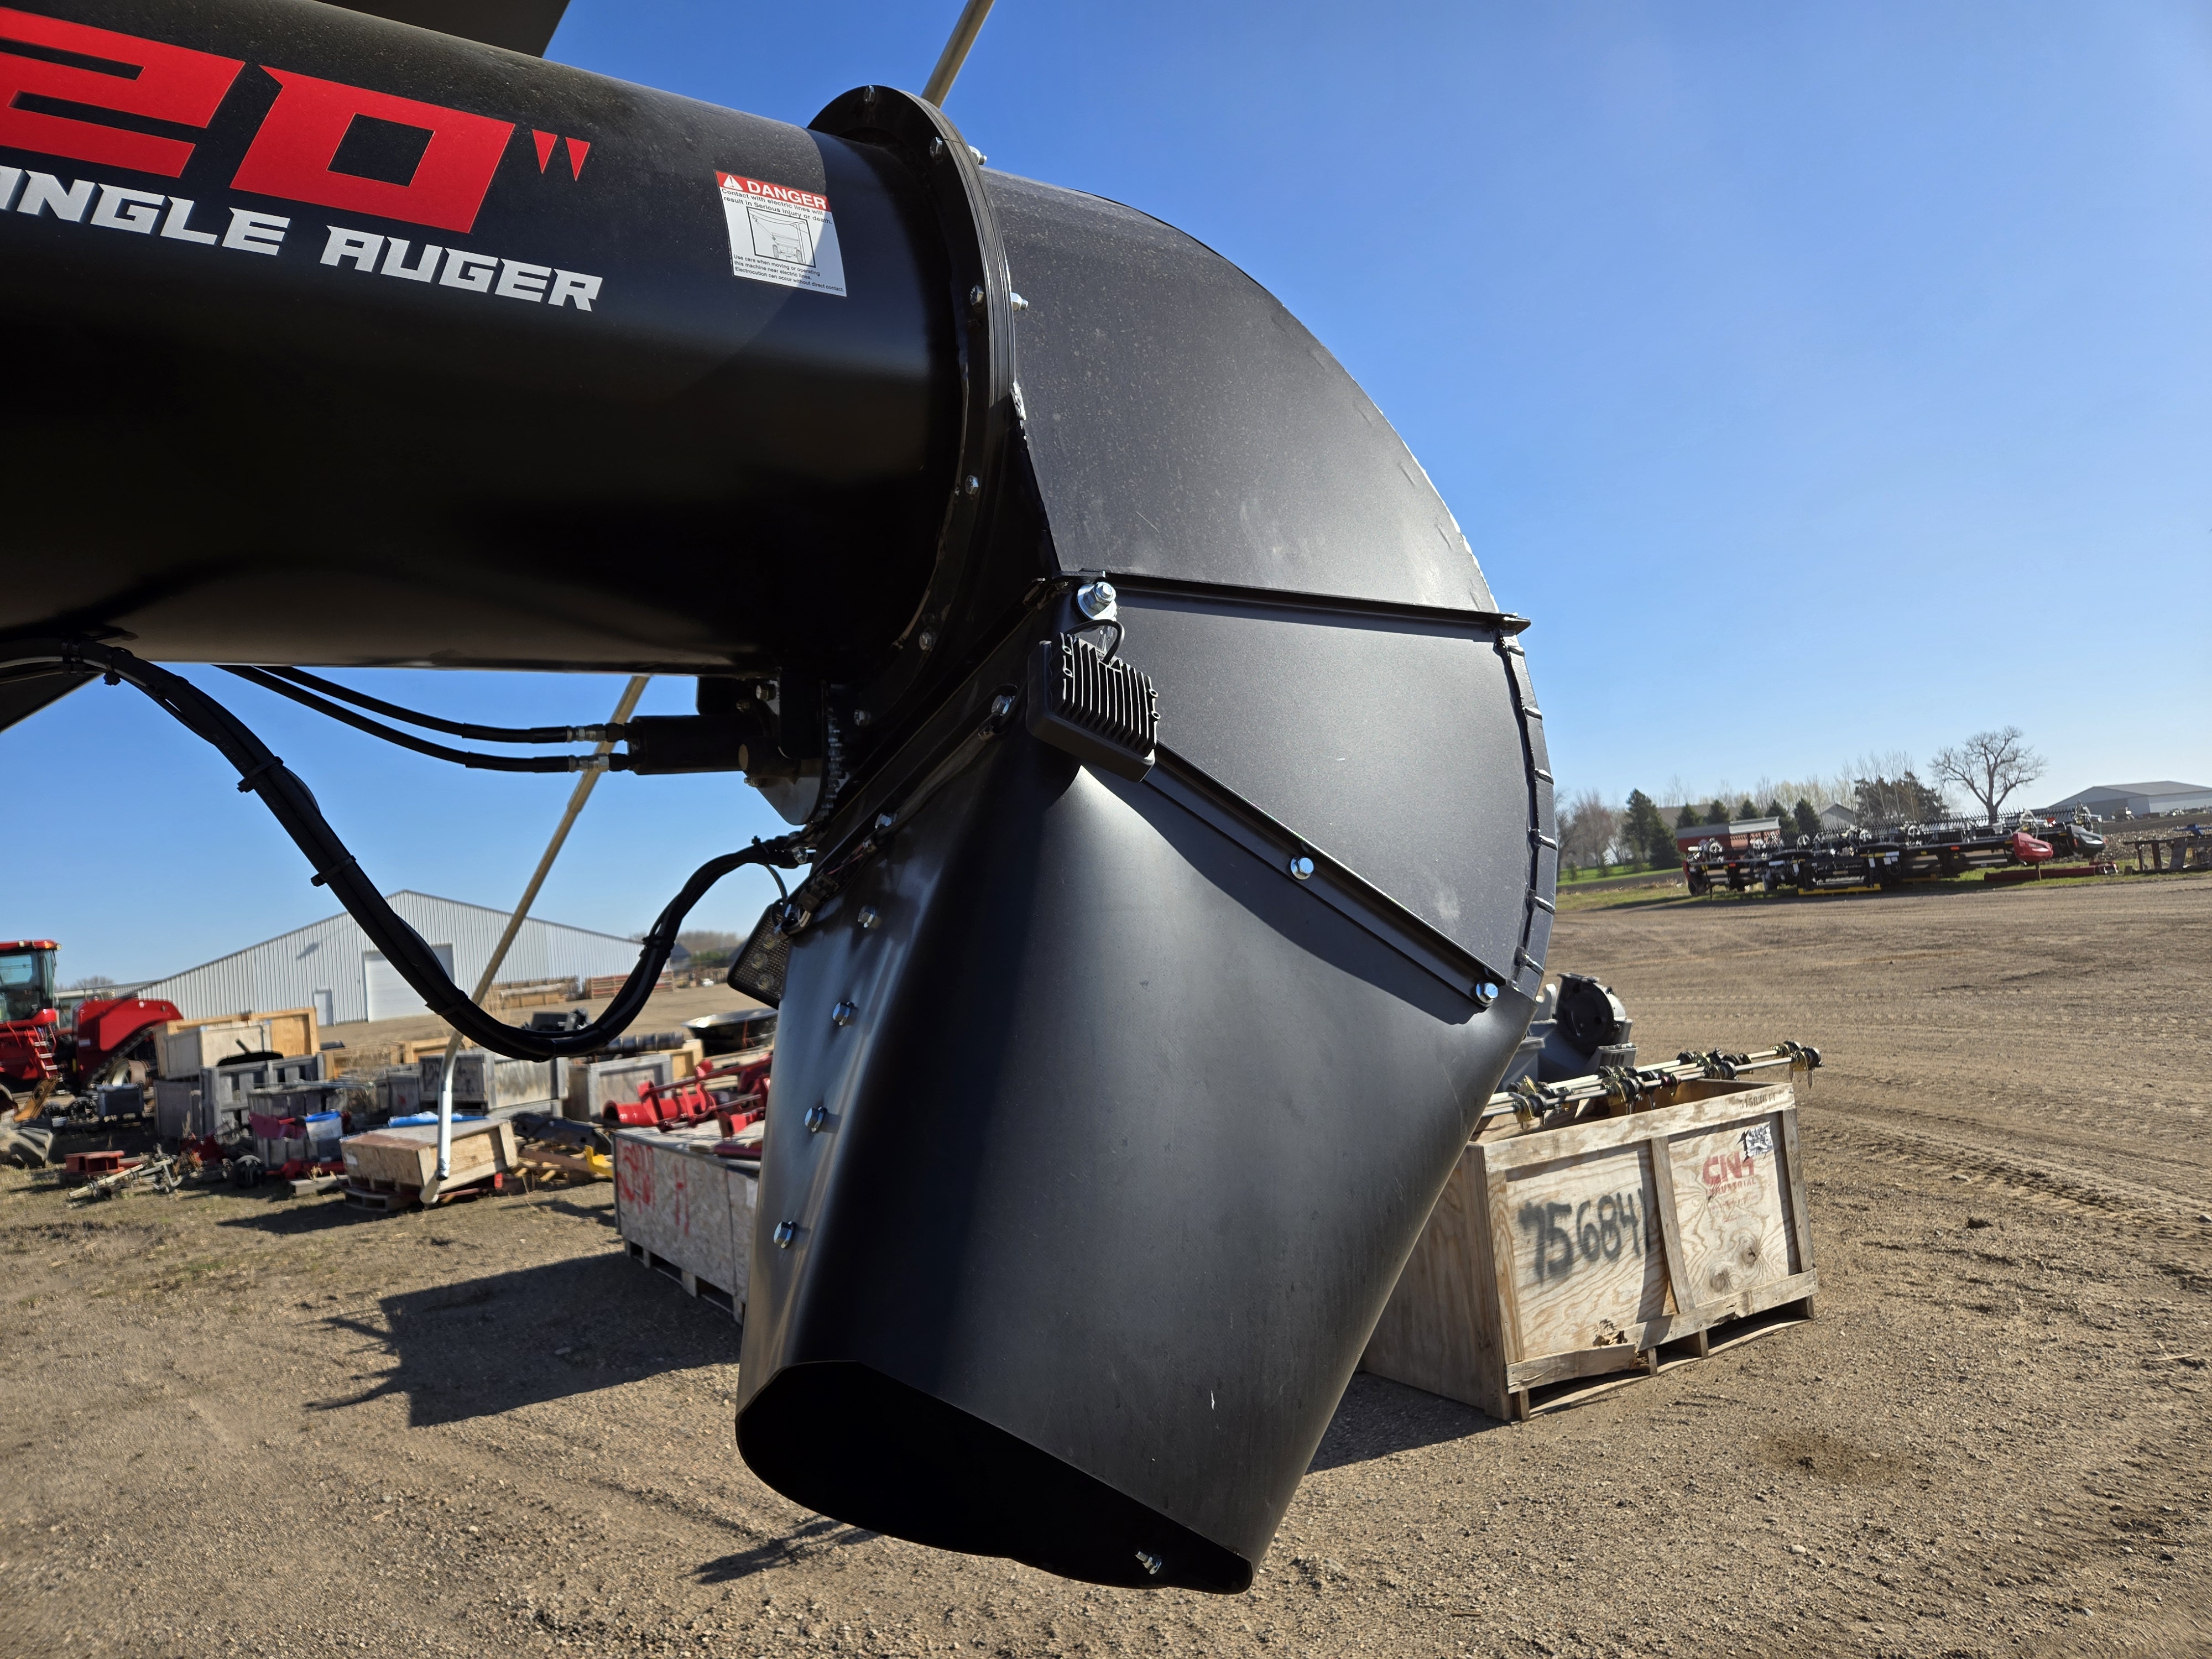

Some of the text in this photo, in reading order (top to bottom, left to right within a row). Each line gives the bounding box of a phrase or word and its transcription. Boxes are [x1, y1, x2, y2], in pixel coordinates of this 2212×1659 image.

[722, 189, 749, 199] Contact
[768, 199, 792, 208] electric
[794, 204, 810, 212] lines
[747, 180, 826, 210] DANGER
[723, 196, 744, 205] result
[754, 202, 781, 212] Serious
[782, 208, 801, 219] injury
[812, 215, 833, 225] death.
[320, 226, 603, 312] AUGER
[735, 267, 768, 276] Electrocution
[771, 262, 790, 270] moving
[797, 268, 820, 276] operating
